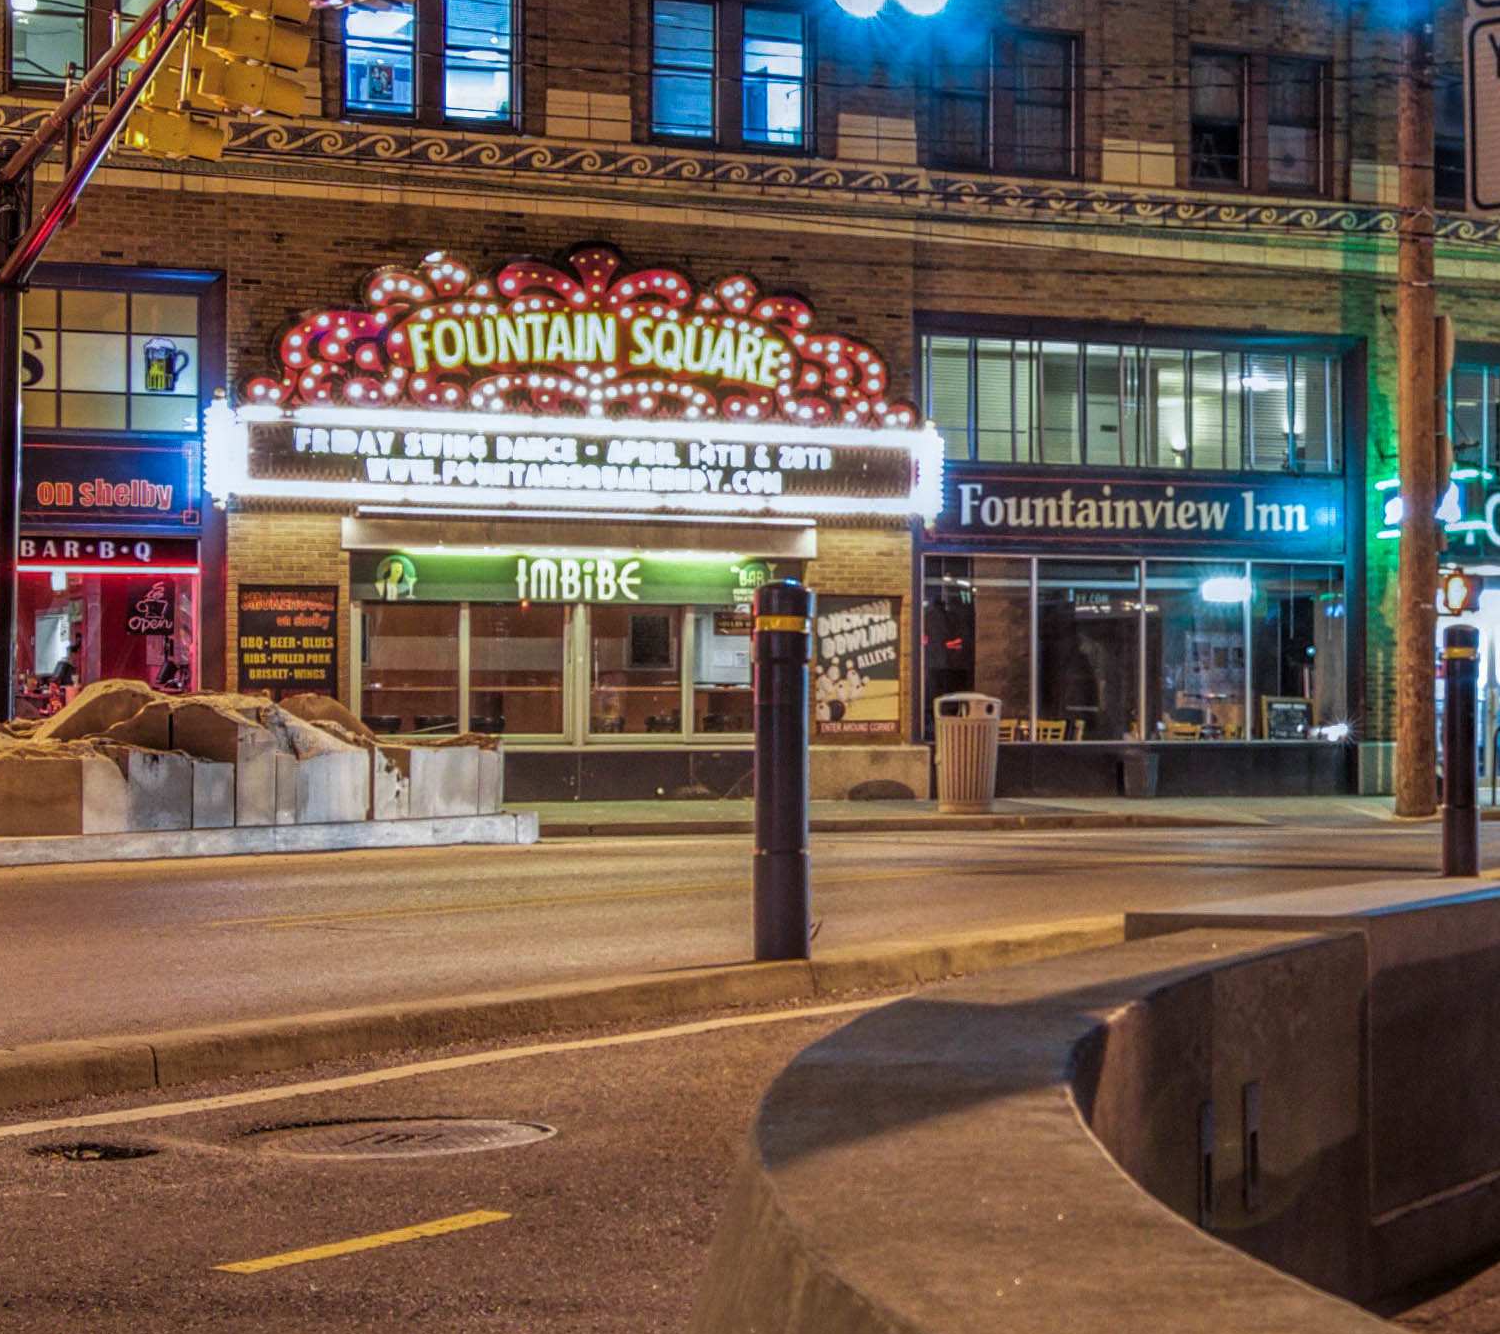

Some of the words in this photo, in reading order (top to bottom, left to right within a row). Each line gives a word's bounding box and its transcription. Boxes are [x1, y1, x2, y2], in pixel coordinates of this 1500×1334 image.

[407, 312, 618, 373] FOUNTAIN
[629, 317, 784, 388] SQUARE
[36, 479, 74, 505] on
[78, 476, 174, 511] shelby
[957, 482, 1230, 531] Fountainview
[1241, 486, 1310, 532] Inn
[128, 616, 174, 634] Open
[241, 636, 263, 649] BBQ
[269, 636, 296, 649] BEER
[857, 646, 896, 669] ALLEYS
